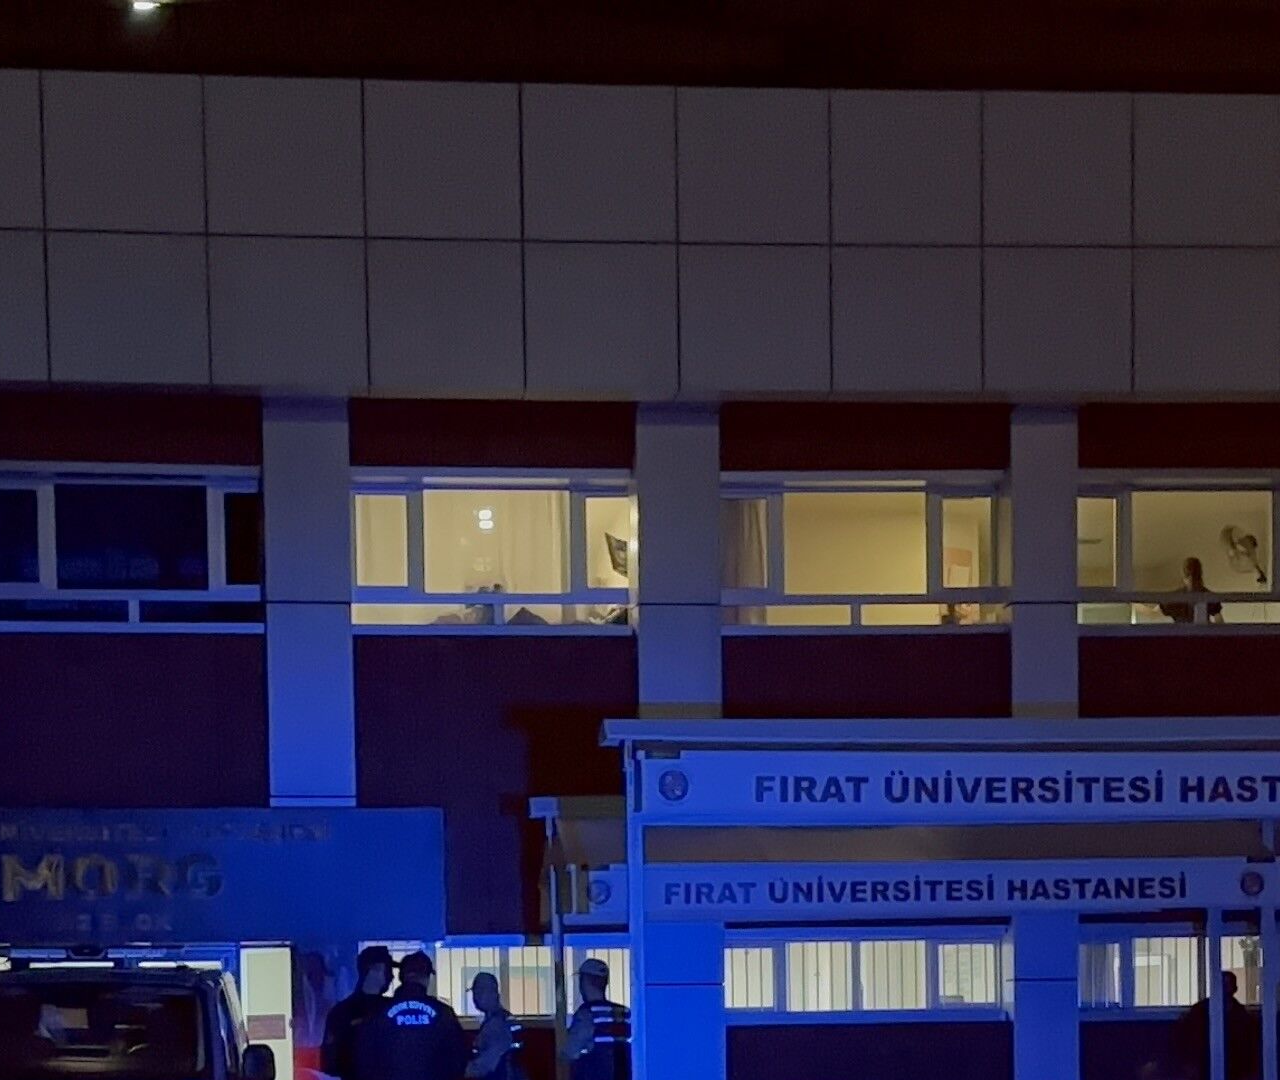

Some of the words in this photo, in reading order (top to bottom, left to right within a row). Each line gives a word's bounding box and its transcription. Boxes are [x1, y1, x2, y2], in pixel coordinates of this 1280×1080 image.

[755, 776, 869, 803] FIRAT
[884, 768, 1164, 804] ÜNİVERSİTESİ
[0, 852, 224, 902] MORG
[664, 881, 756, 904] FIRAT
[769, 873, 995, 904] ÜNİVERSİTESİ
[1006, 871, 1188, 901] HASTANESİ
